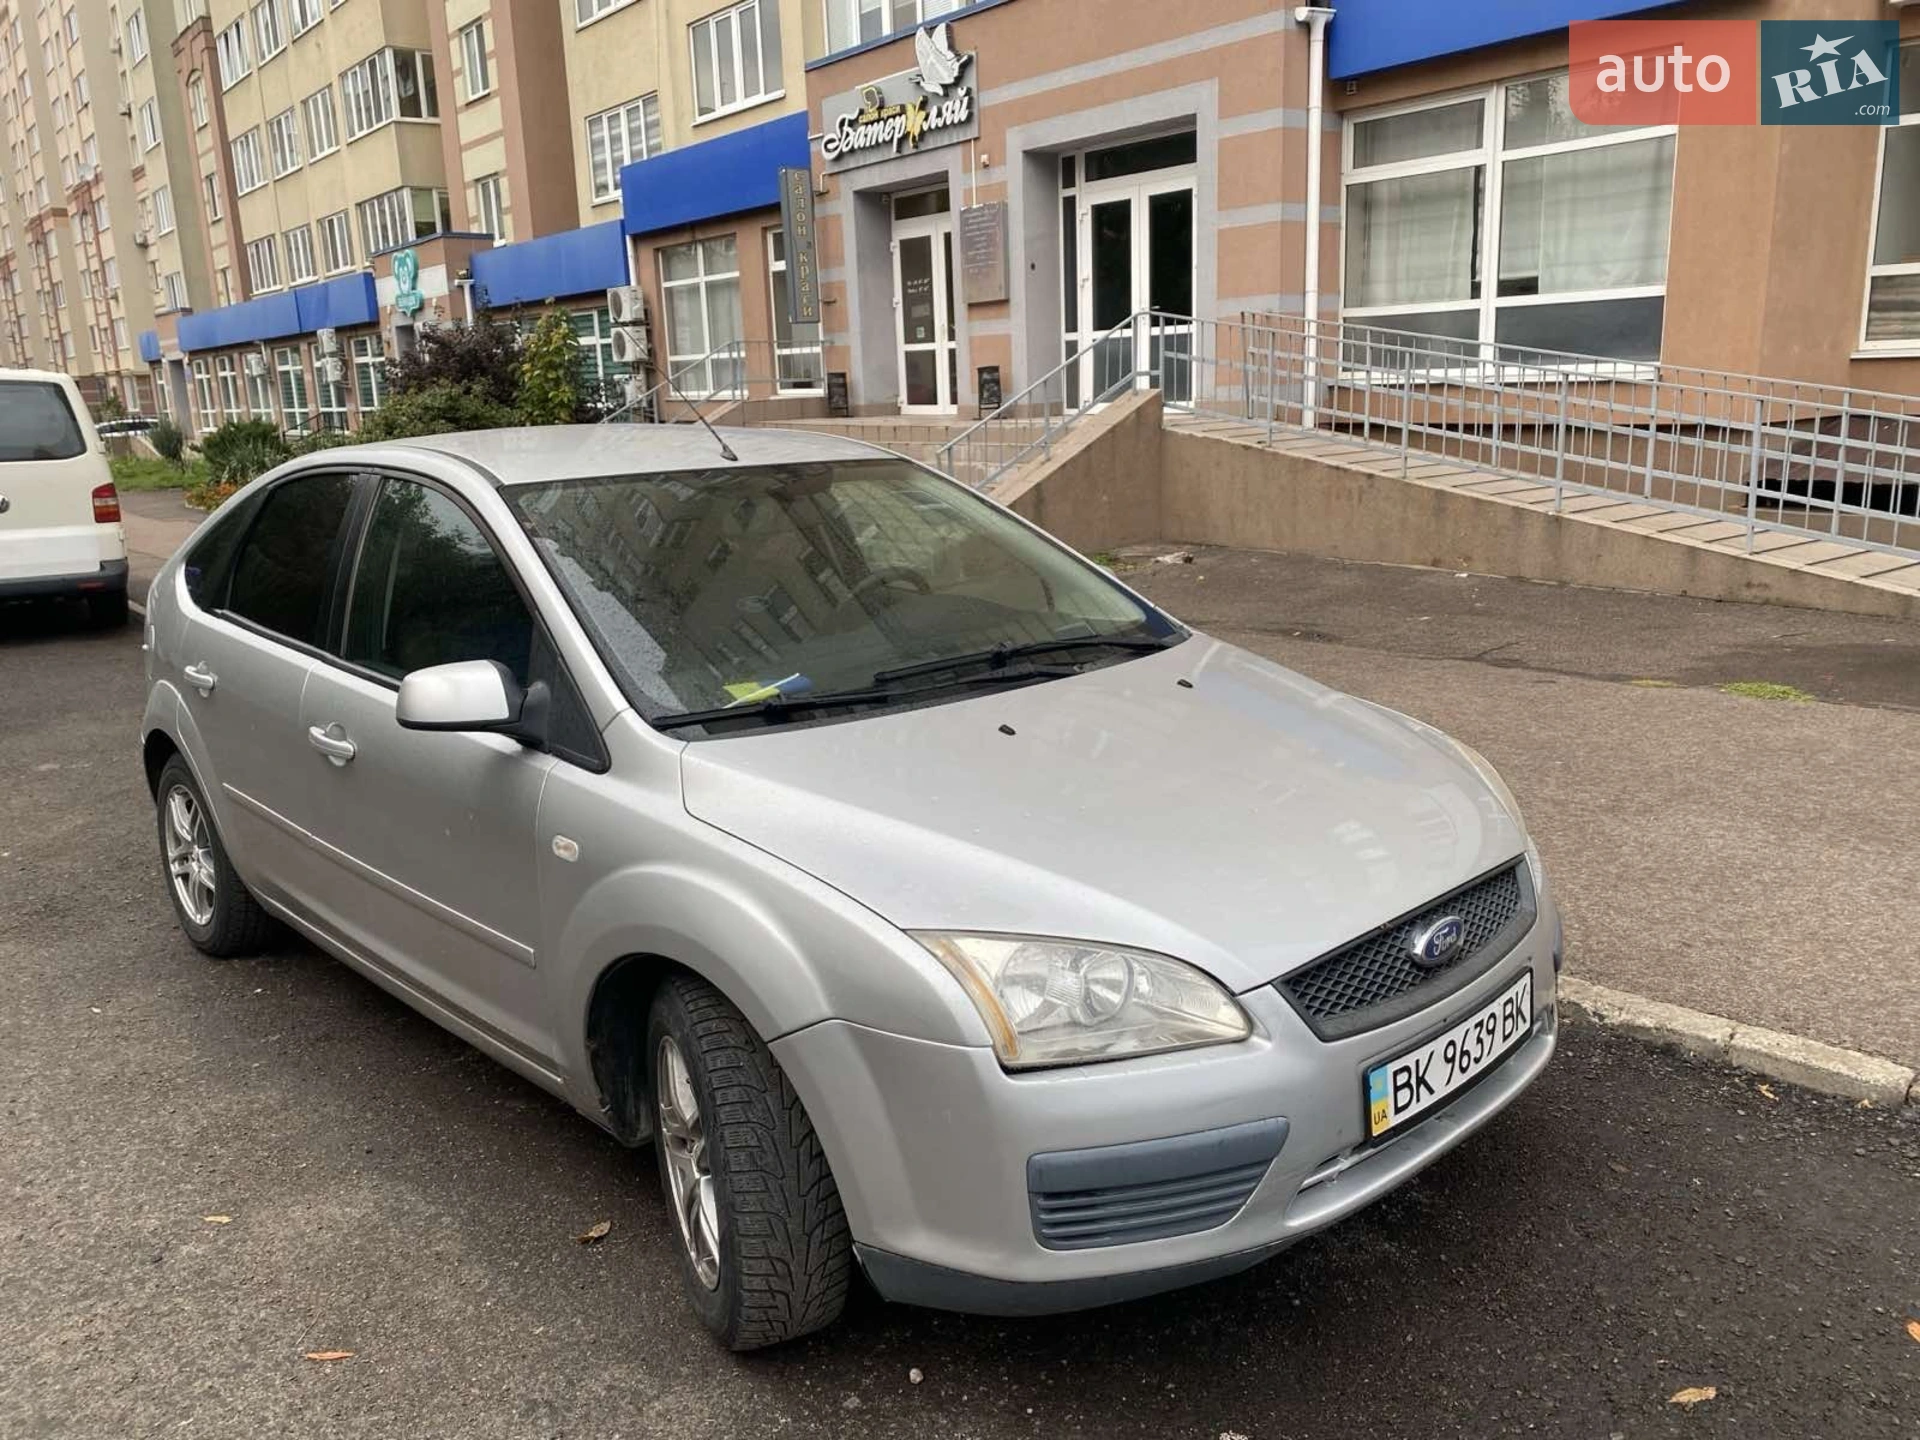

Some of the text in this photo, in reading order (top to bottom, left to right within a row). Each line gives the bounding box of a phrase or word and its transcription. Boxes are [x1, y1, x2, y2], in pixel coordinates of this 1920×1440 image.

[1433, 926, 1457, 955] Ford
[1393, 983, 1527, 1115] BK 9639 BK
[1373, 1109, 1387, 1125] UA
